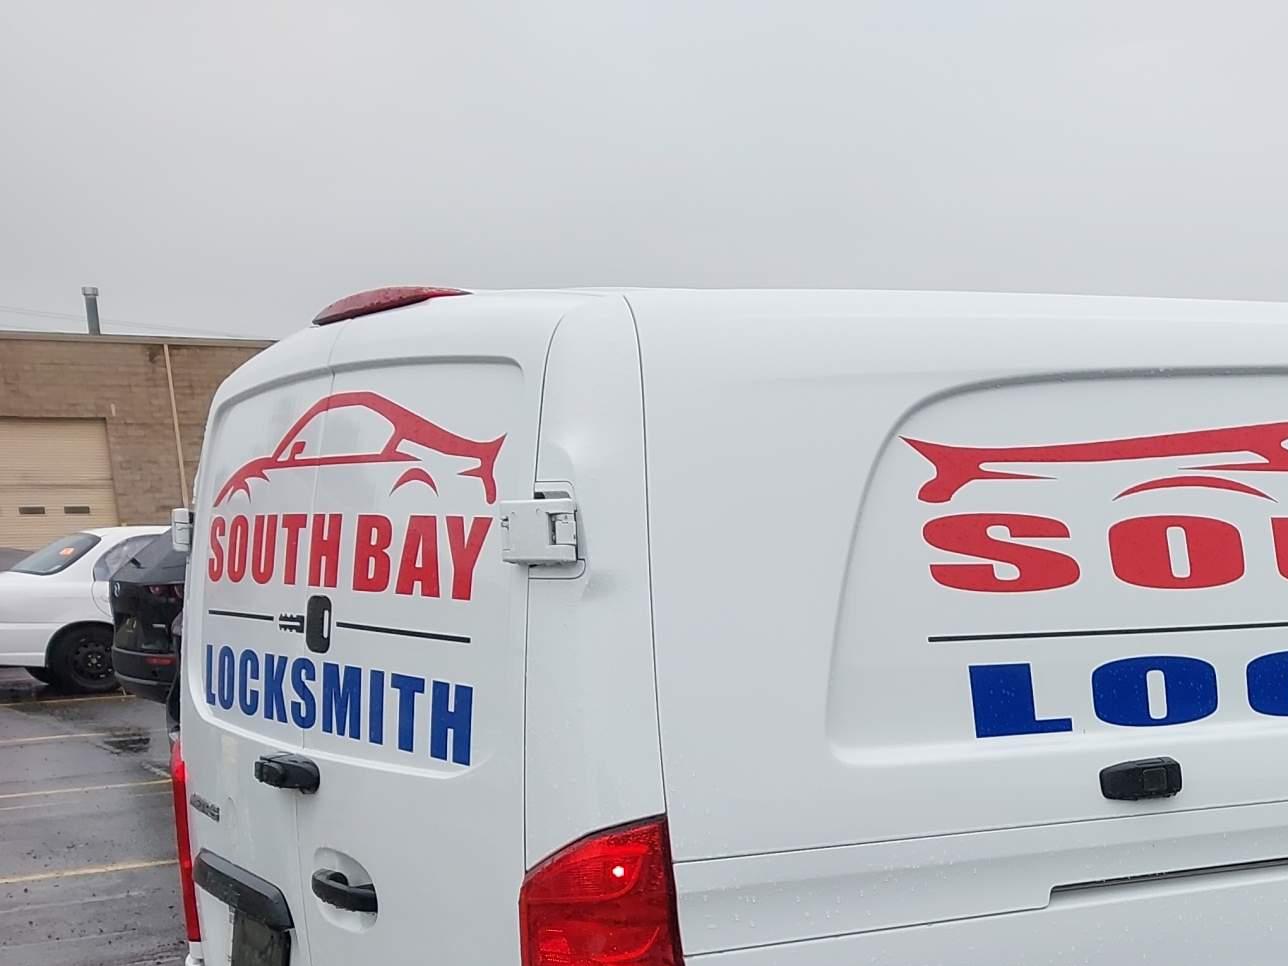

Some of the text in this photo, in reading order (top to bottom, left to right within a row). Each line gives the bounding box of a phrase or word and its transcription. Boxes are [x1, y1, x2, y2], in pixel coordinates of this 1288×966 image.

[208, 513, 493, 601] SOUTH BAY
[206, 644, 473, 766] LOCKSMITH
